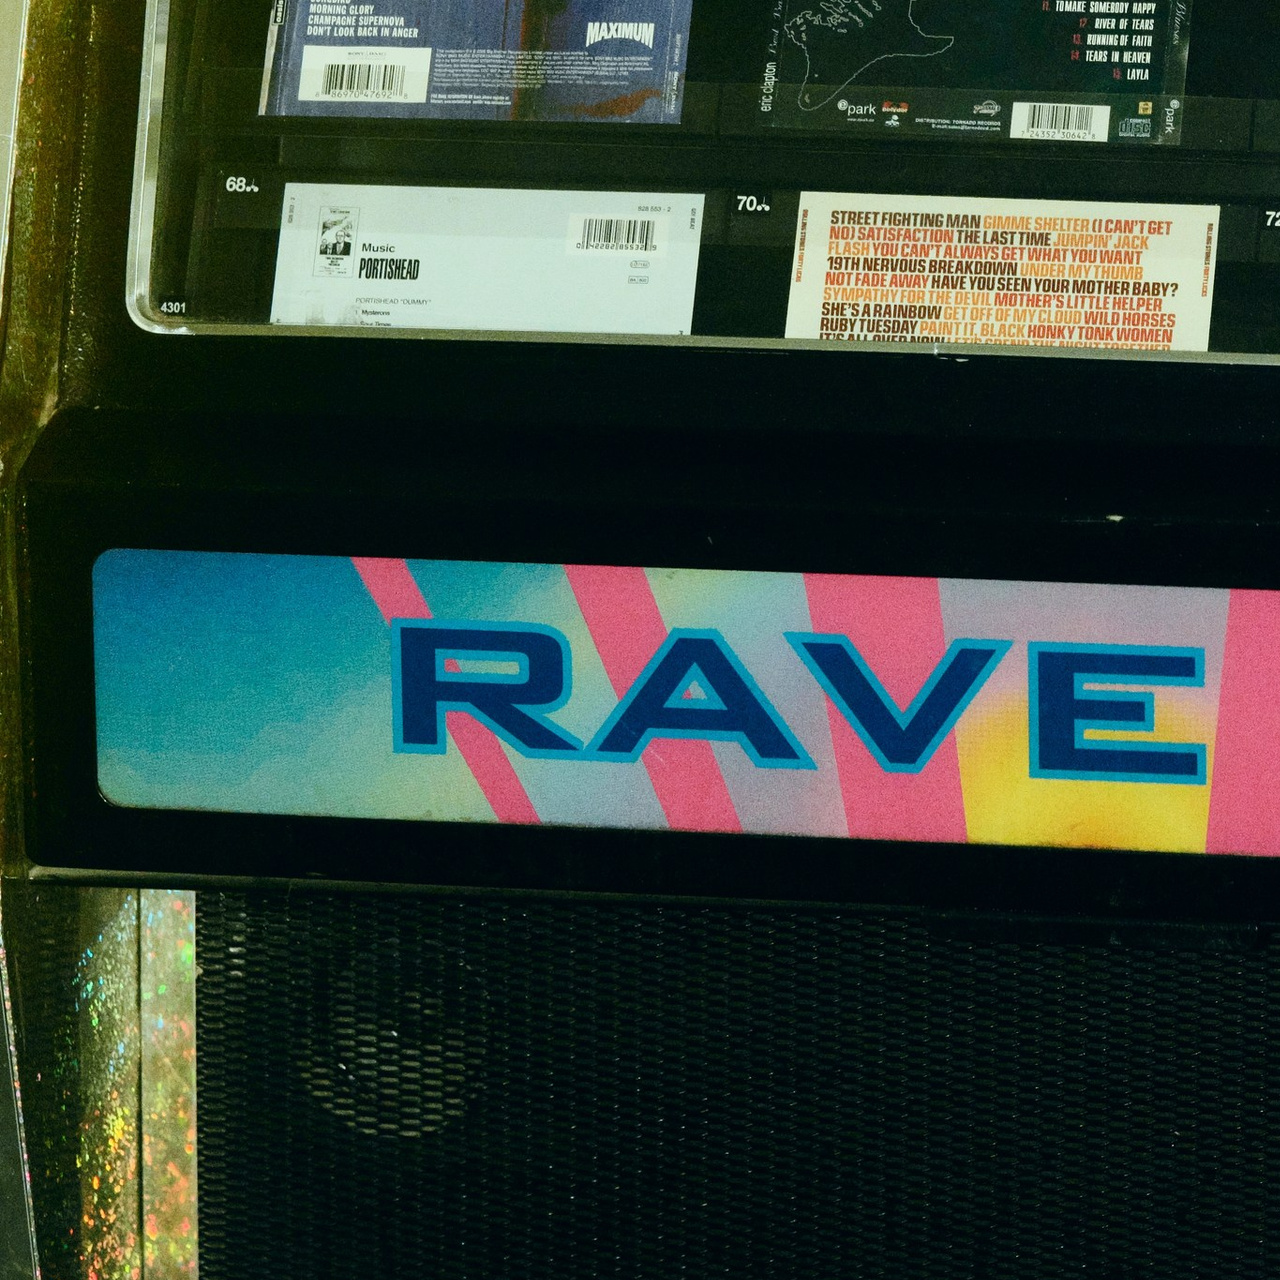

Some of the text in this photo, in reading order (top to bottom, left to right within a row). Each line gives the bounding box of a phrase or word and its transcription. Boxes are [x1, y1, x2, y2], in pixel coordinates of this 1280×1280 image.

[585, 21, 655, 49] MAXIMUM
[1086, 50, 1151, 64] TEARS IN HEAVEN
[1127, 68, 1149, 81] LAYLA
[226, 177, 246, 192] 68
[736, 196, 757, 211] 70
[830, 210, 981, 229] STREET FIGHTING MAN
[983, 215, 1090, 233] GIMME SHELTER
[360, 242, 396, 254] Music
[358, 257, 420, 280] PORTISHEAD
[931, 275, 1179, 298] HAVE YOU SEEN YOUR MOTHER BABY?
[160, 302, 186, 315] 4301
[391, 618, 1207, 785] RAVE
